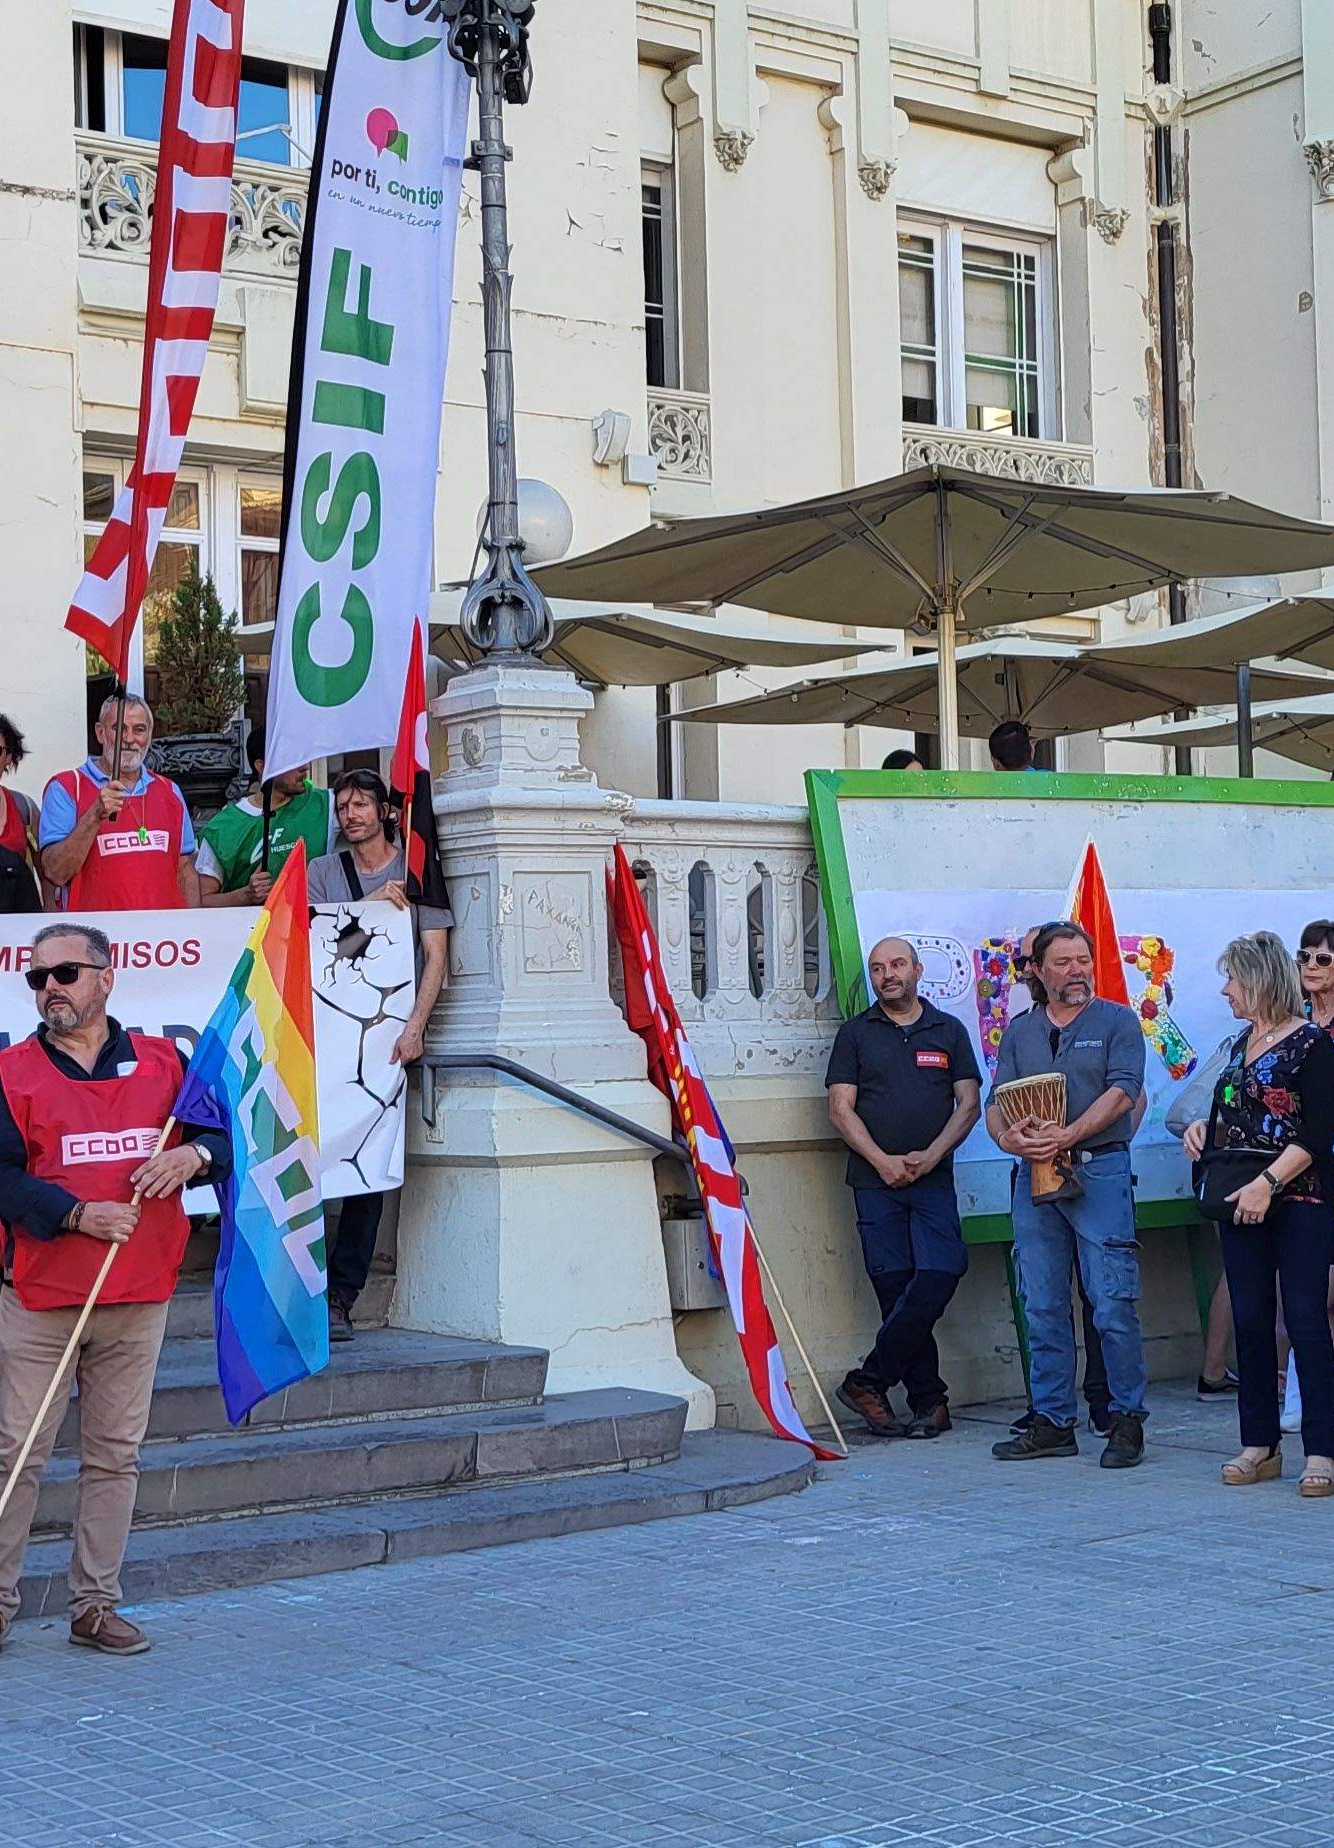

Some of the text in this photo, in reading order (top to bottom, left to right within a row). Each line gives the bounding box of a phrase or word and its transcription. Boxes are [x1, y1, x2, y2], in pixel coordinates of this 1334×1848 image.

[330, 158, 361, 182] por
[388, 180, 444, 209] contigo
[290, 247, 395, 707] CSIF
[69, 1134, 138, 1158] CCOO
